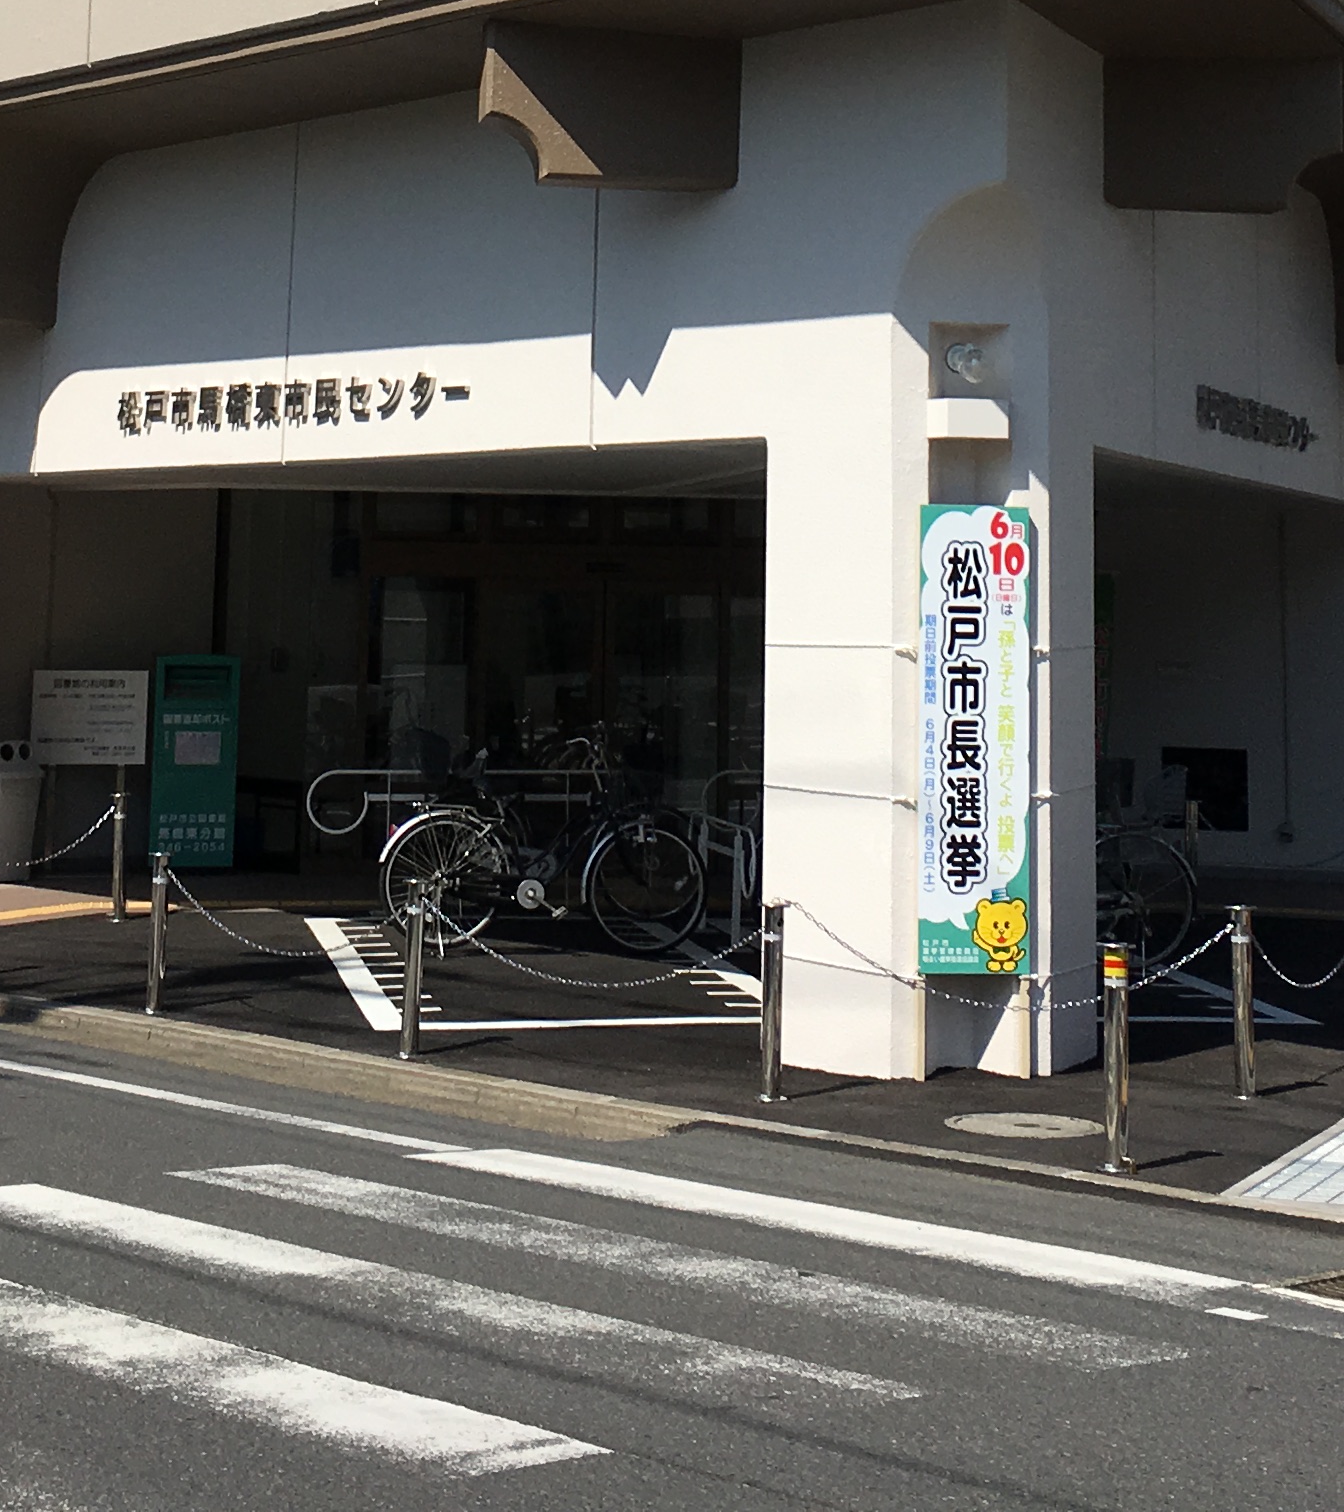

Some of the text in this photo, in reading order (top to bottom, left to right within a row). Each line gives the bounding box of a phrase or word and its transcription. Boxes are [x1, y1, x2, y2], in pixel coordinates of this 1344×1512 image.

[118, 371, 471, 437] 松戸市馬橋東市民センター
[991, 511, 1023, 539] 6月
[946, 546, 983, 888] 松戸市長選挙
